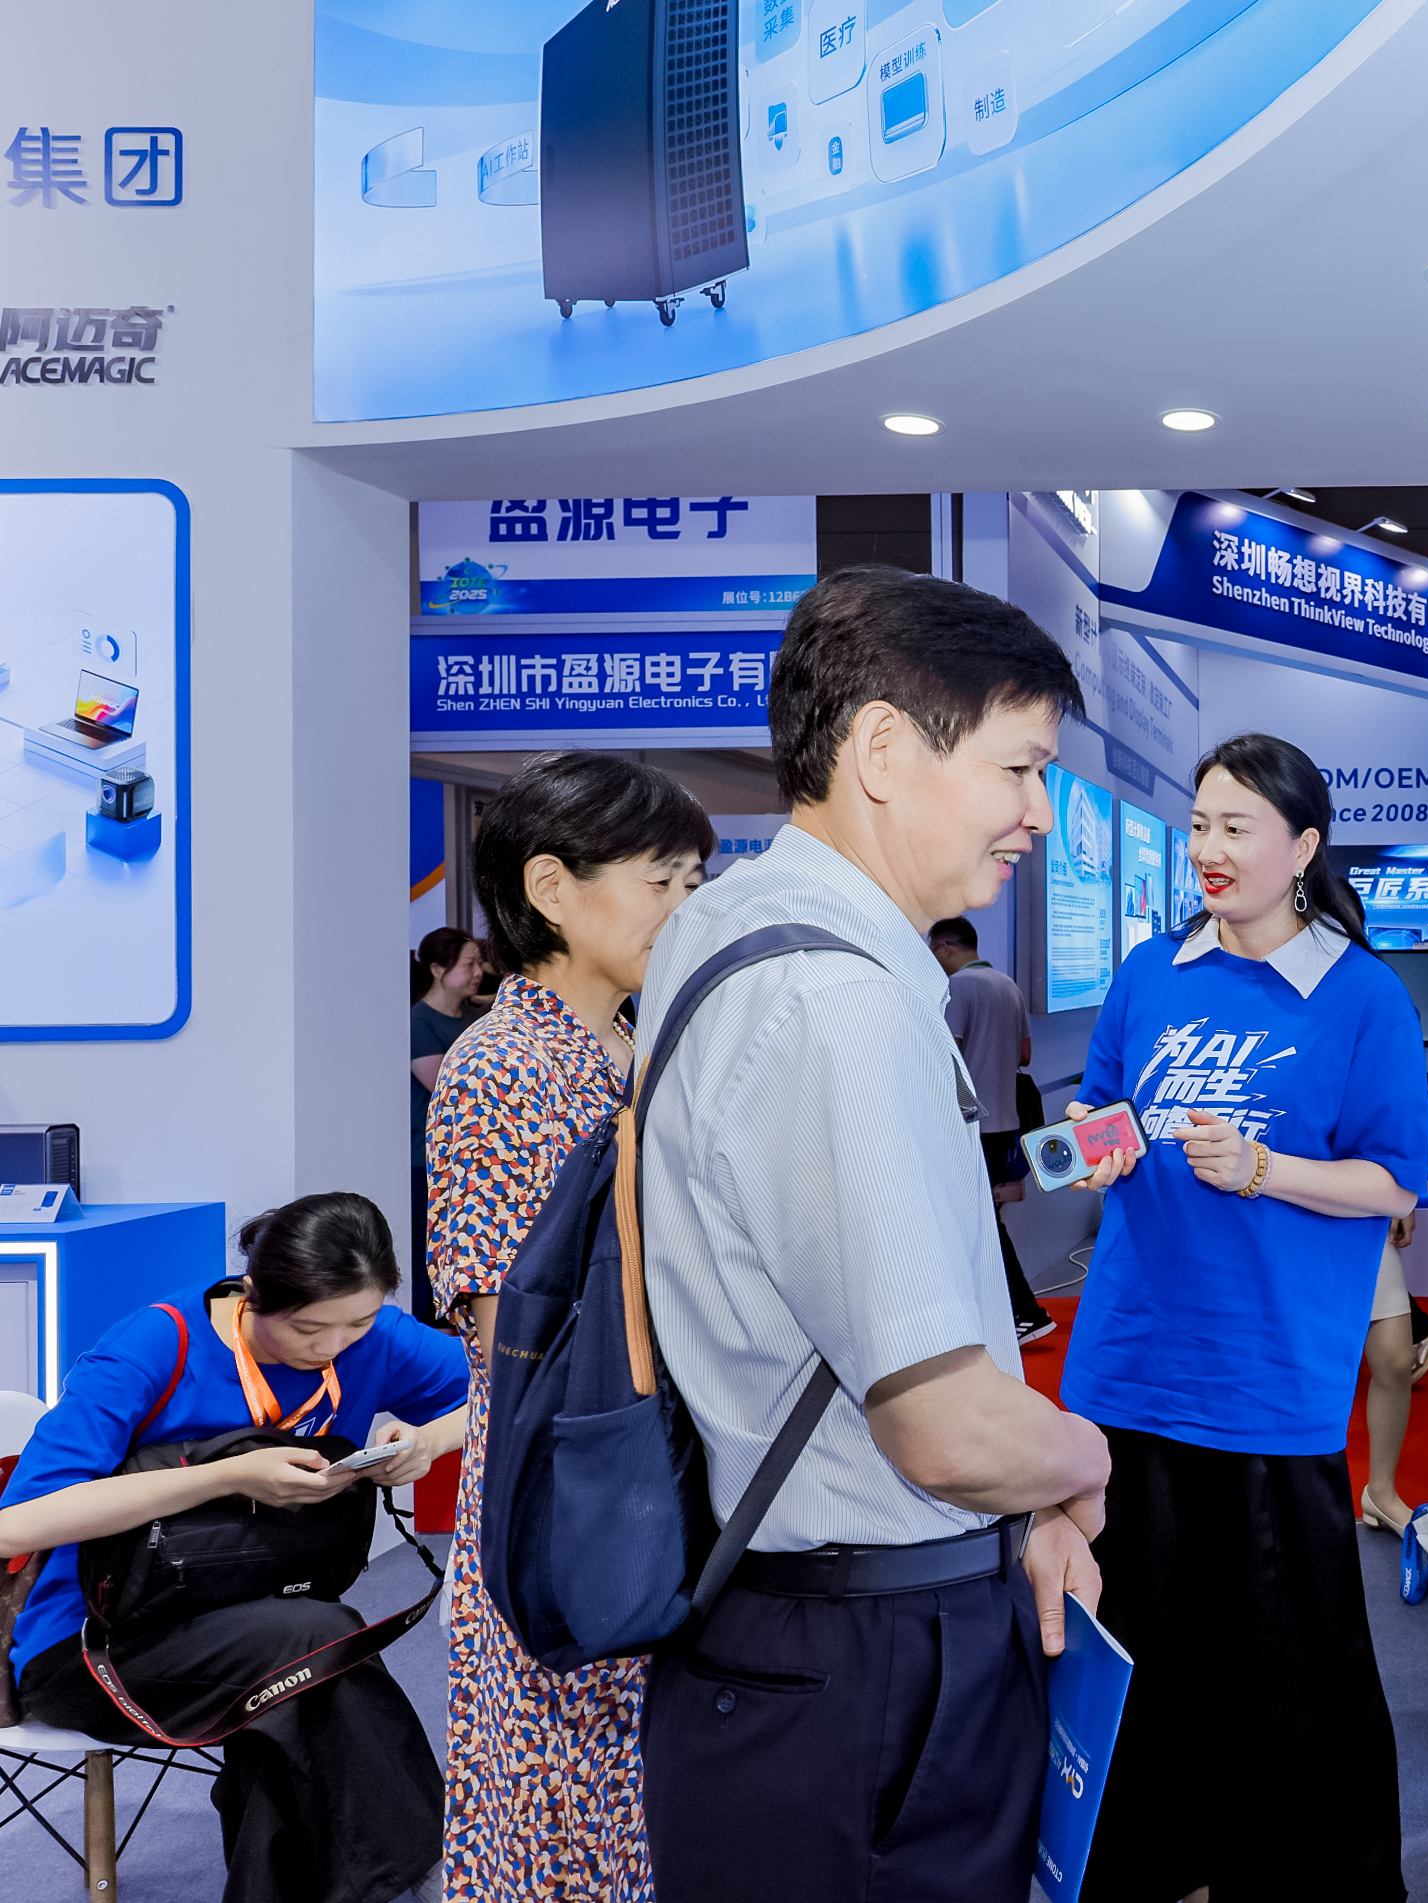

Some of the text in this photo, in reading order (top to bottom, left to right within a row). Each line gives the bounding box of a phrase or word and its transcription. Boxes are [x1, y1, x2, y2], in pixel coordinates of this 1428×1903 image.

[819, 16, 856, 59] 医疗
[879, 41, 926, 82] 模型训练
[974, 88, 1006, 122] 制造
[3, 127, 183, 208] 集团
[481, 138, 530, 180] AI工作站
[0, 306, 164, 352] 阿迈奇
[0, 355, 158, 385] ACEMAGIC
[449, 588, 488, 600] 2025
[722, 590, 803, 605] 展位号:12B6
[1211, 576, 1289, 614] Shenzhen
[1291, 598, 1365, 634] ThinkView
[437, 651, 778, 697] 深圳市盈源电子有
[437, 699, 474, 711] Shen
[479, 698, 521, 711] ZHEN
[525, 697, 550, 710] SHI
[556, 697, 624, 712] Yingyuan
[629, 695, 713, 709] Electronics
[1371, 804, 1428, 823] 2008
[1349, 867, 1381, 875] Great
[1386, 866, 1425, 875] Master
[1153, 1068, 1253, 1103] 而生
[282, 1581, 311, 1594] EOS
[97, 1664, 119, 1693] EOS
[245, 1665, 312, 1712] Canon
